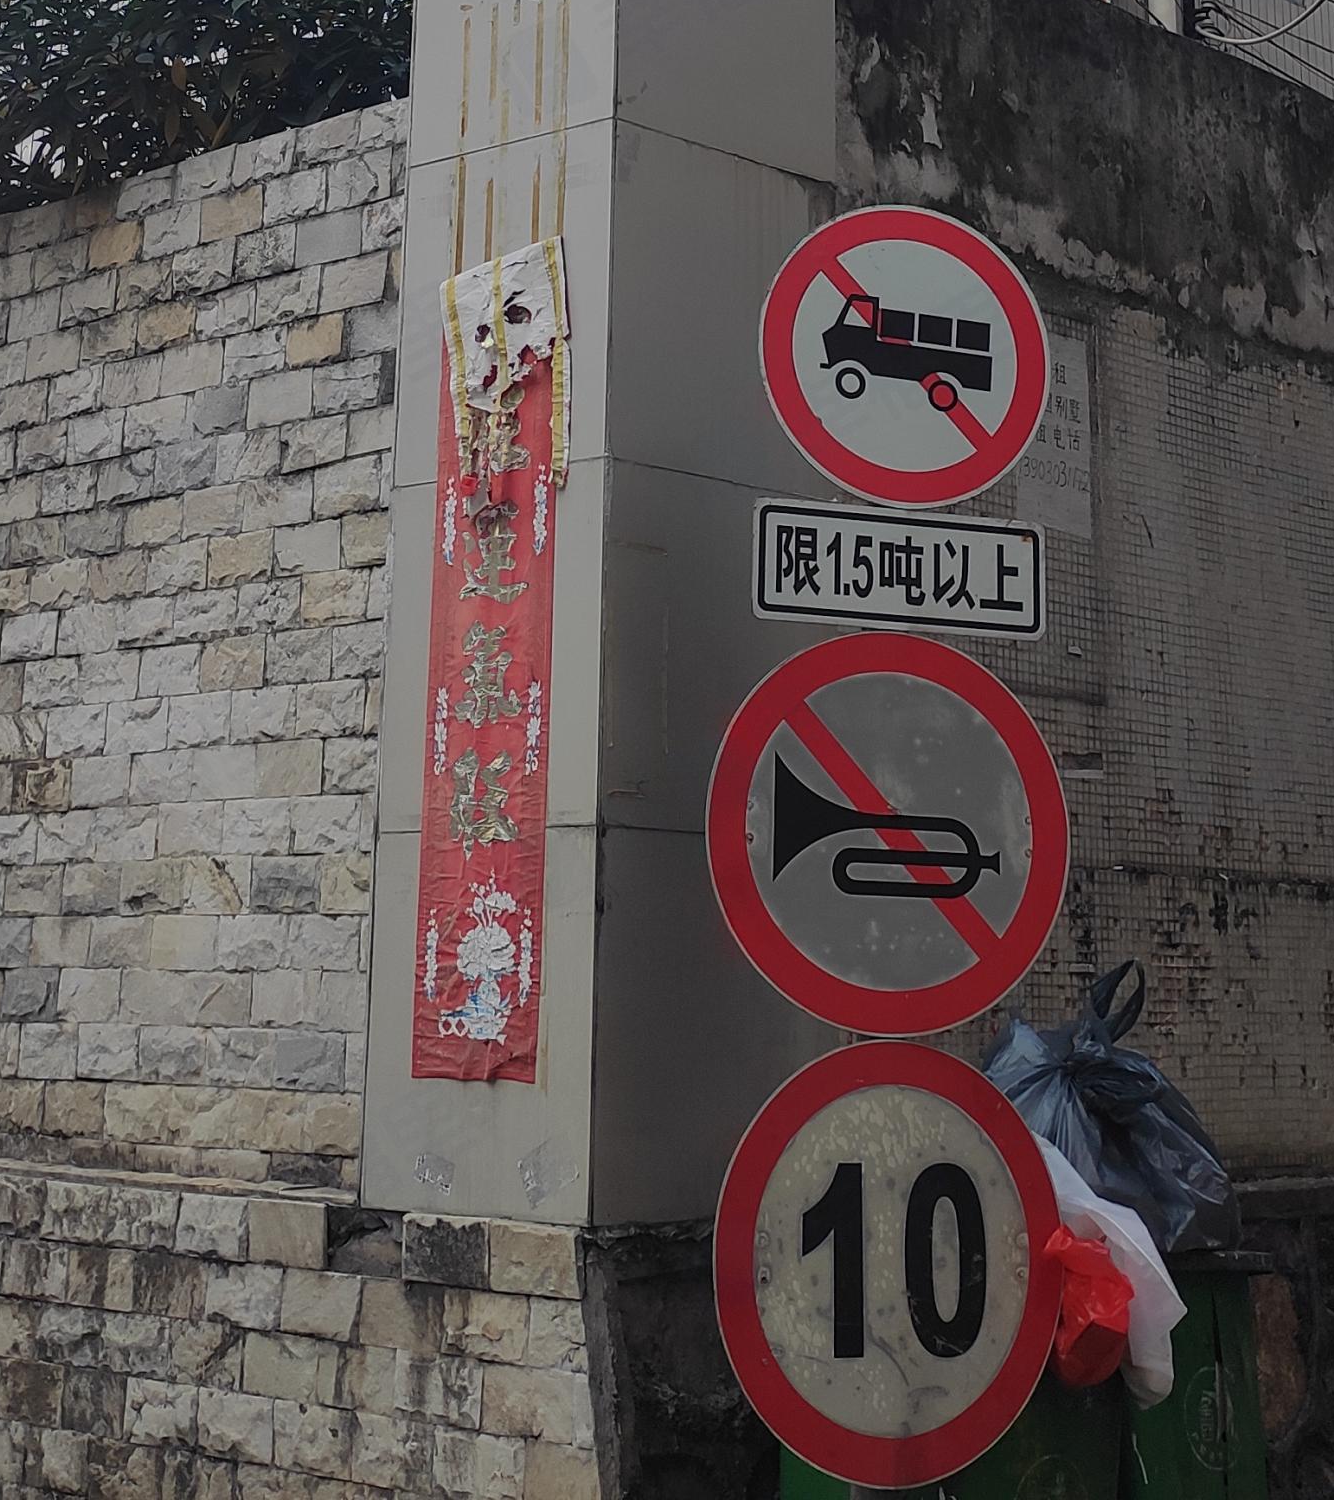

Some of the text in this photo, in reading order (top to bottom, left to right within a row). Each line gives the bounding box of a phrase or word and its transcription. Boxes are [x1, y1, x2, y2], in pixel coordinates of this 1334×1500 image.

[775, 524, 1025, 613] 限1.5吨以上
[801, 1162, 987, 1359] 10
